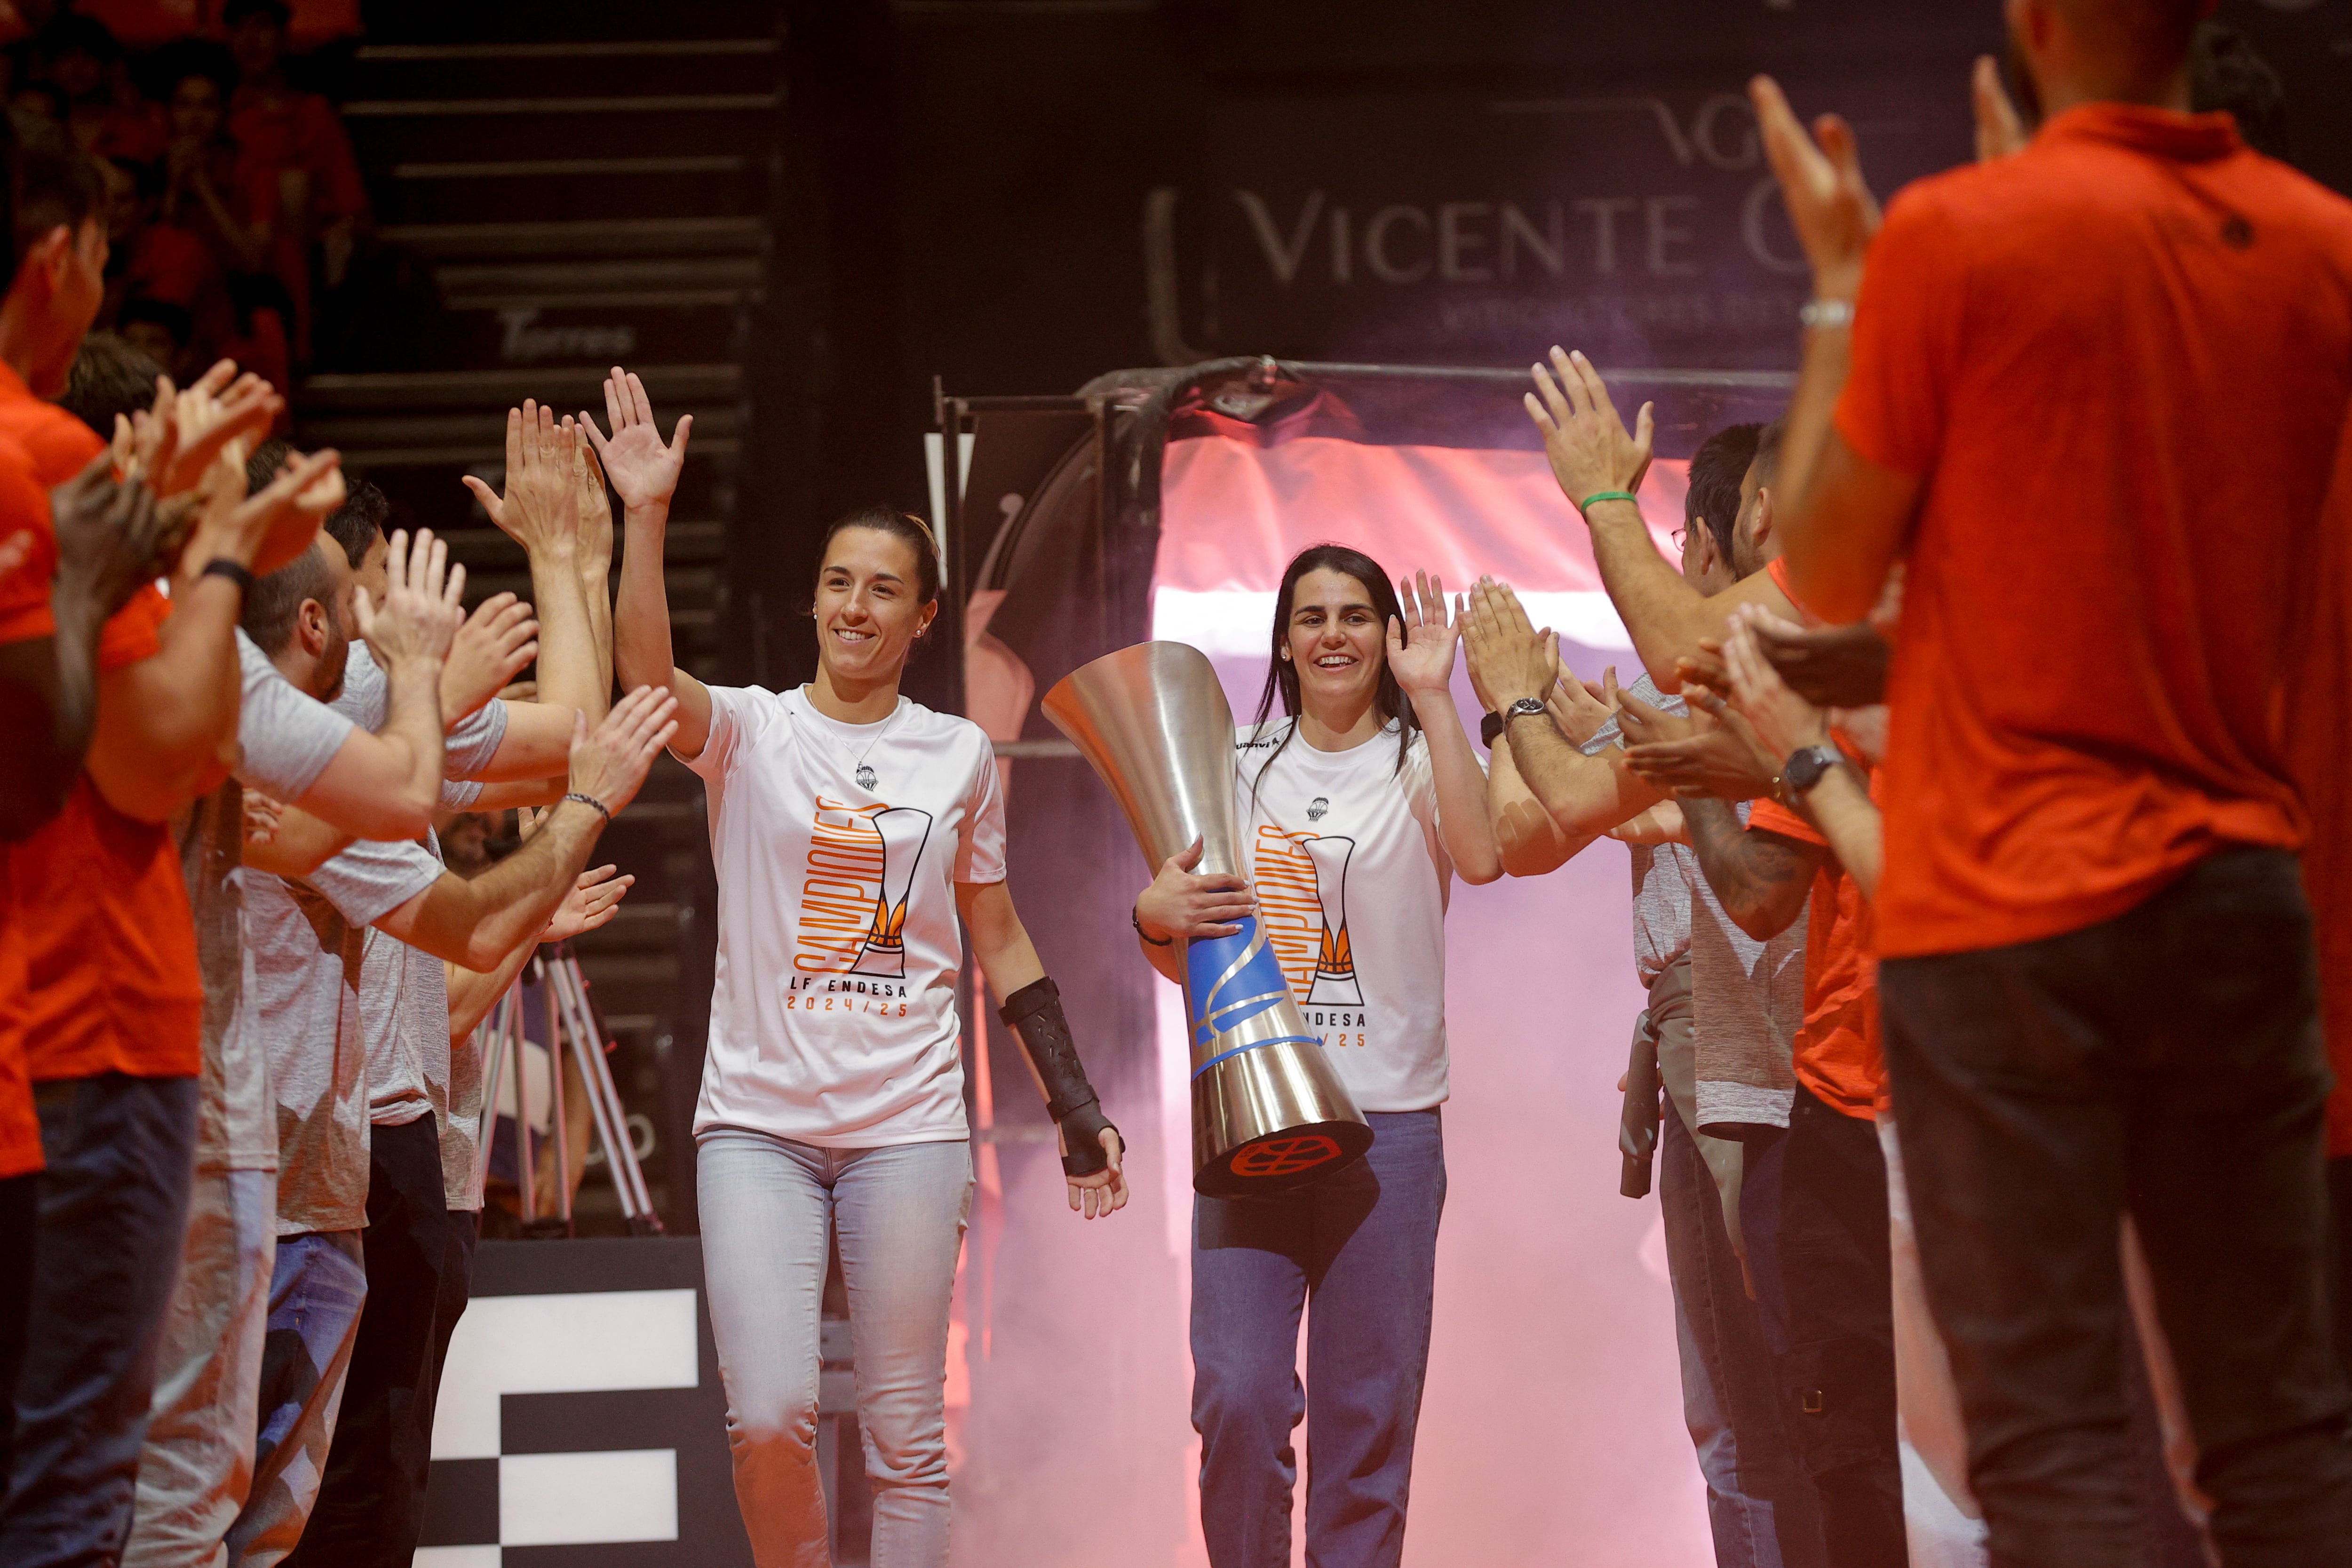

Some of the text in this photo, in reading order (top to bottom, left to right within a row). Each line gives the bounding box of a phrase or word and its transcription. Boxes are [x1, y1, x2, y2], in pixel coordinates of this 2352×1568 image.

[1233, 189, 1703, 284] VICENTE
[794, 795, 890, 974] CAMPIONES
[790, 976, 907, 998] LF ENDESA
[787, 995, 907, 1017] 2024/25
[1303, 1012, 1366, 1027] NDESA
